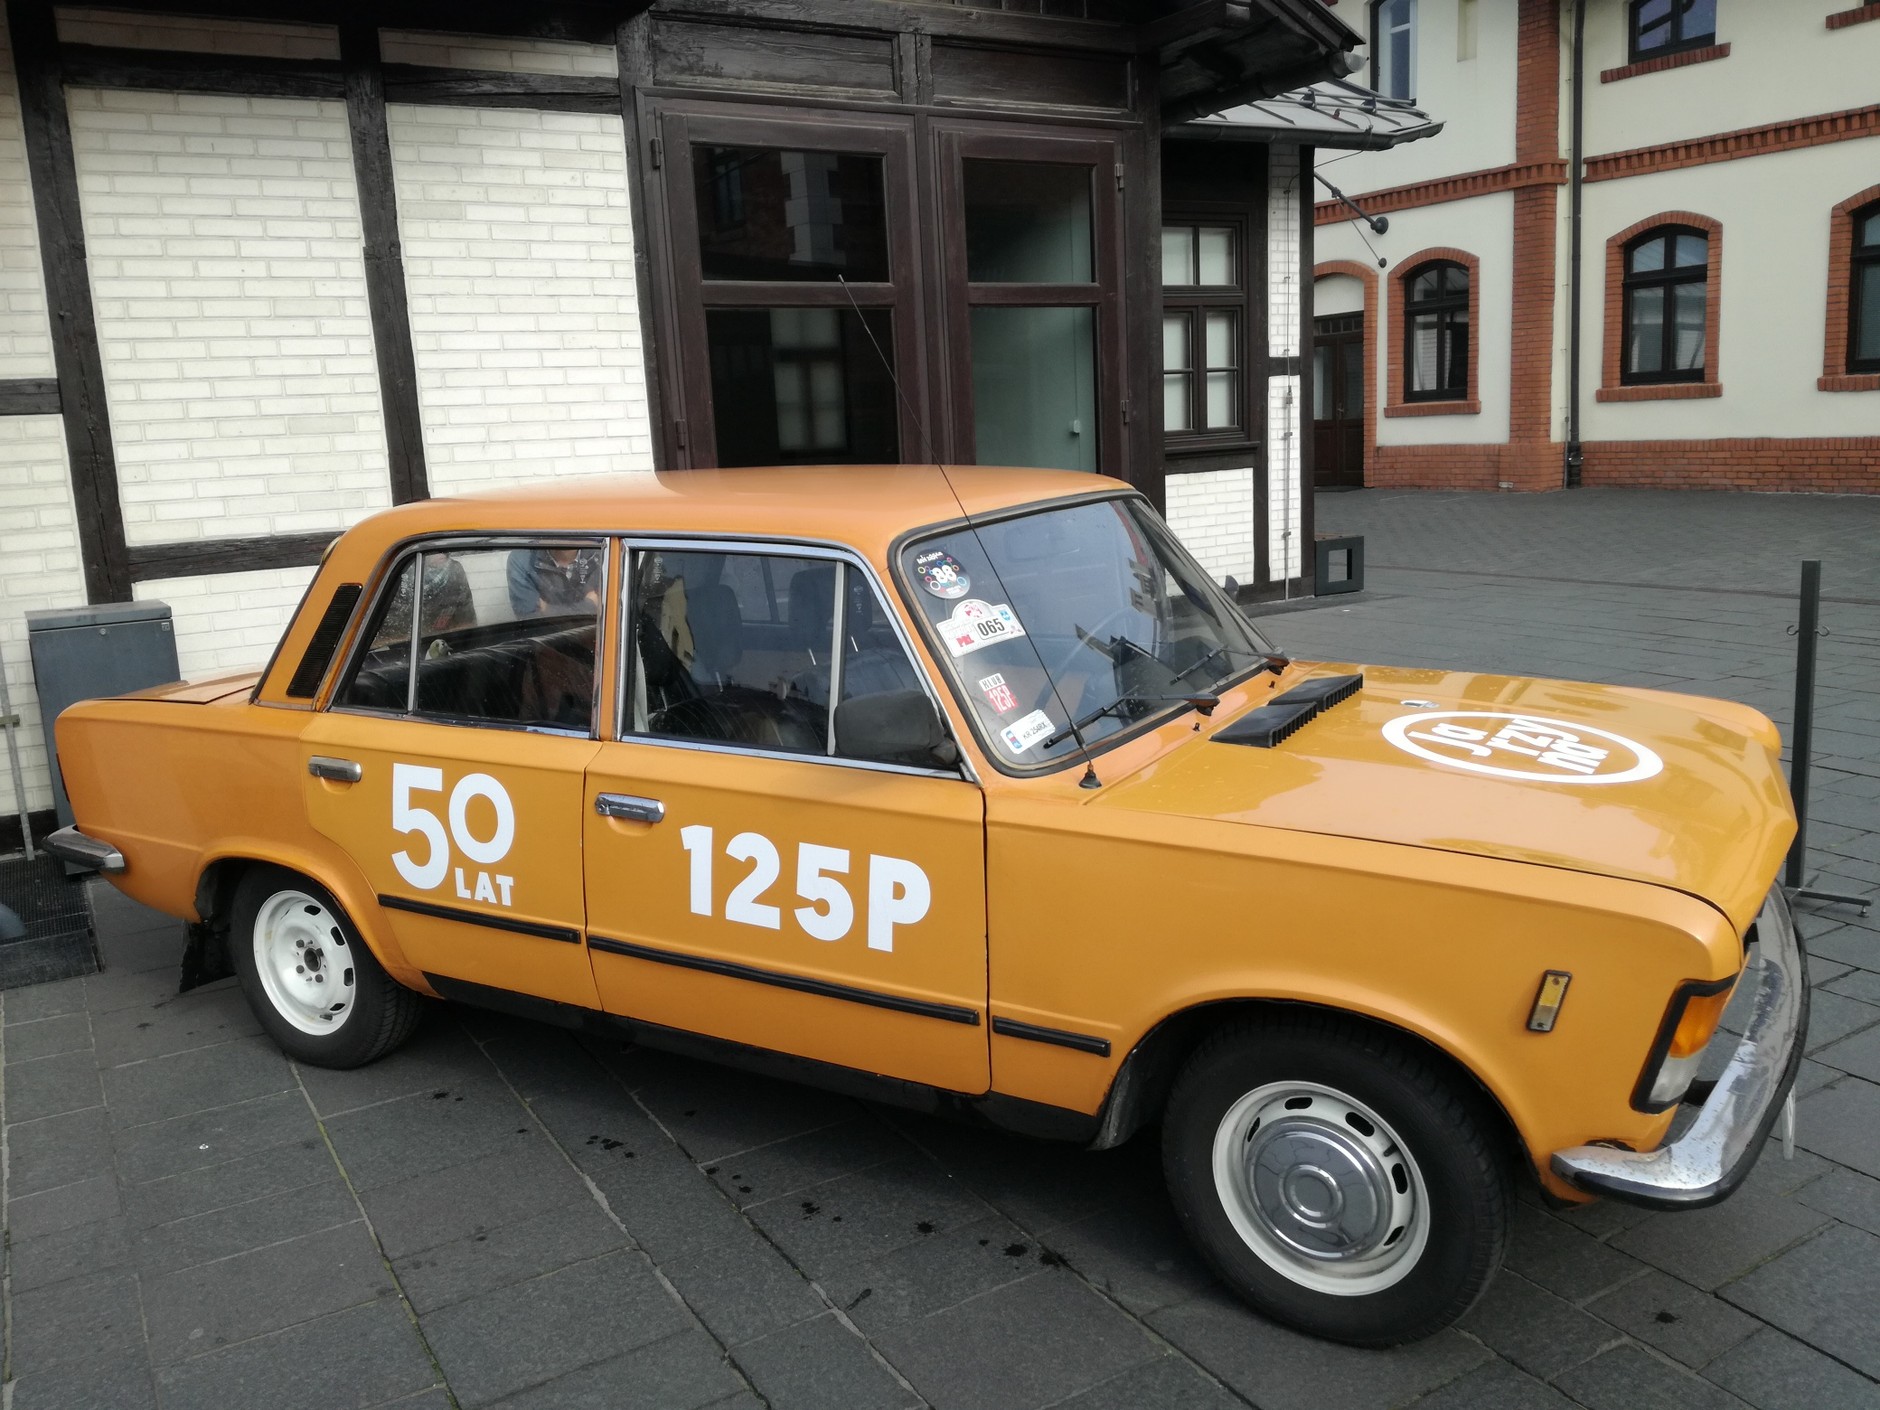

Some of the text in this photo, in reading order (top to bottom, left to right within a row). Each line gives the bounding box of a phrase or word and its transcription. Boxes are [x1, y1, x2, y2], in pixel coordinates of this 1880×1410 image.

[931, 565, 957, 583] 88
[977, 618, 1005, 636] 065
[981, 675, 1003, 690] KLUB
[988, 685, 1016, 713] 125P
[391, 762, 515, 890] 50
[455, 867, 514, 907] LAT
[680, 824, 932, 953] 125P
